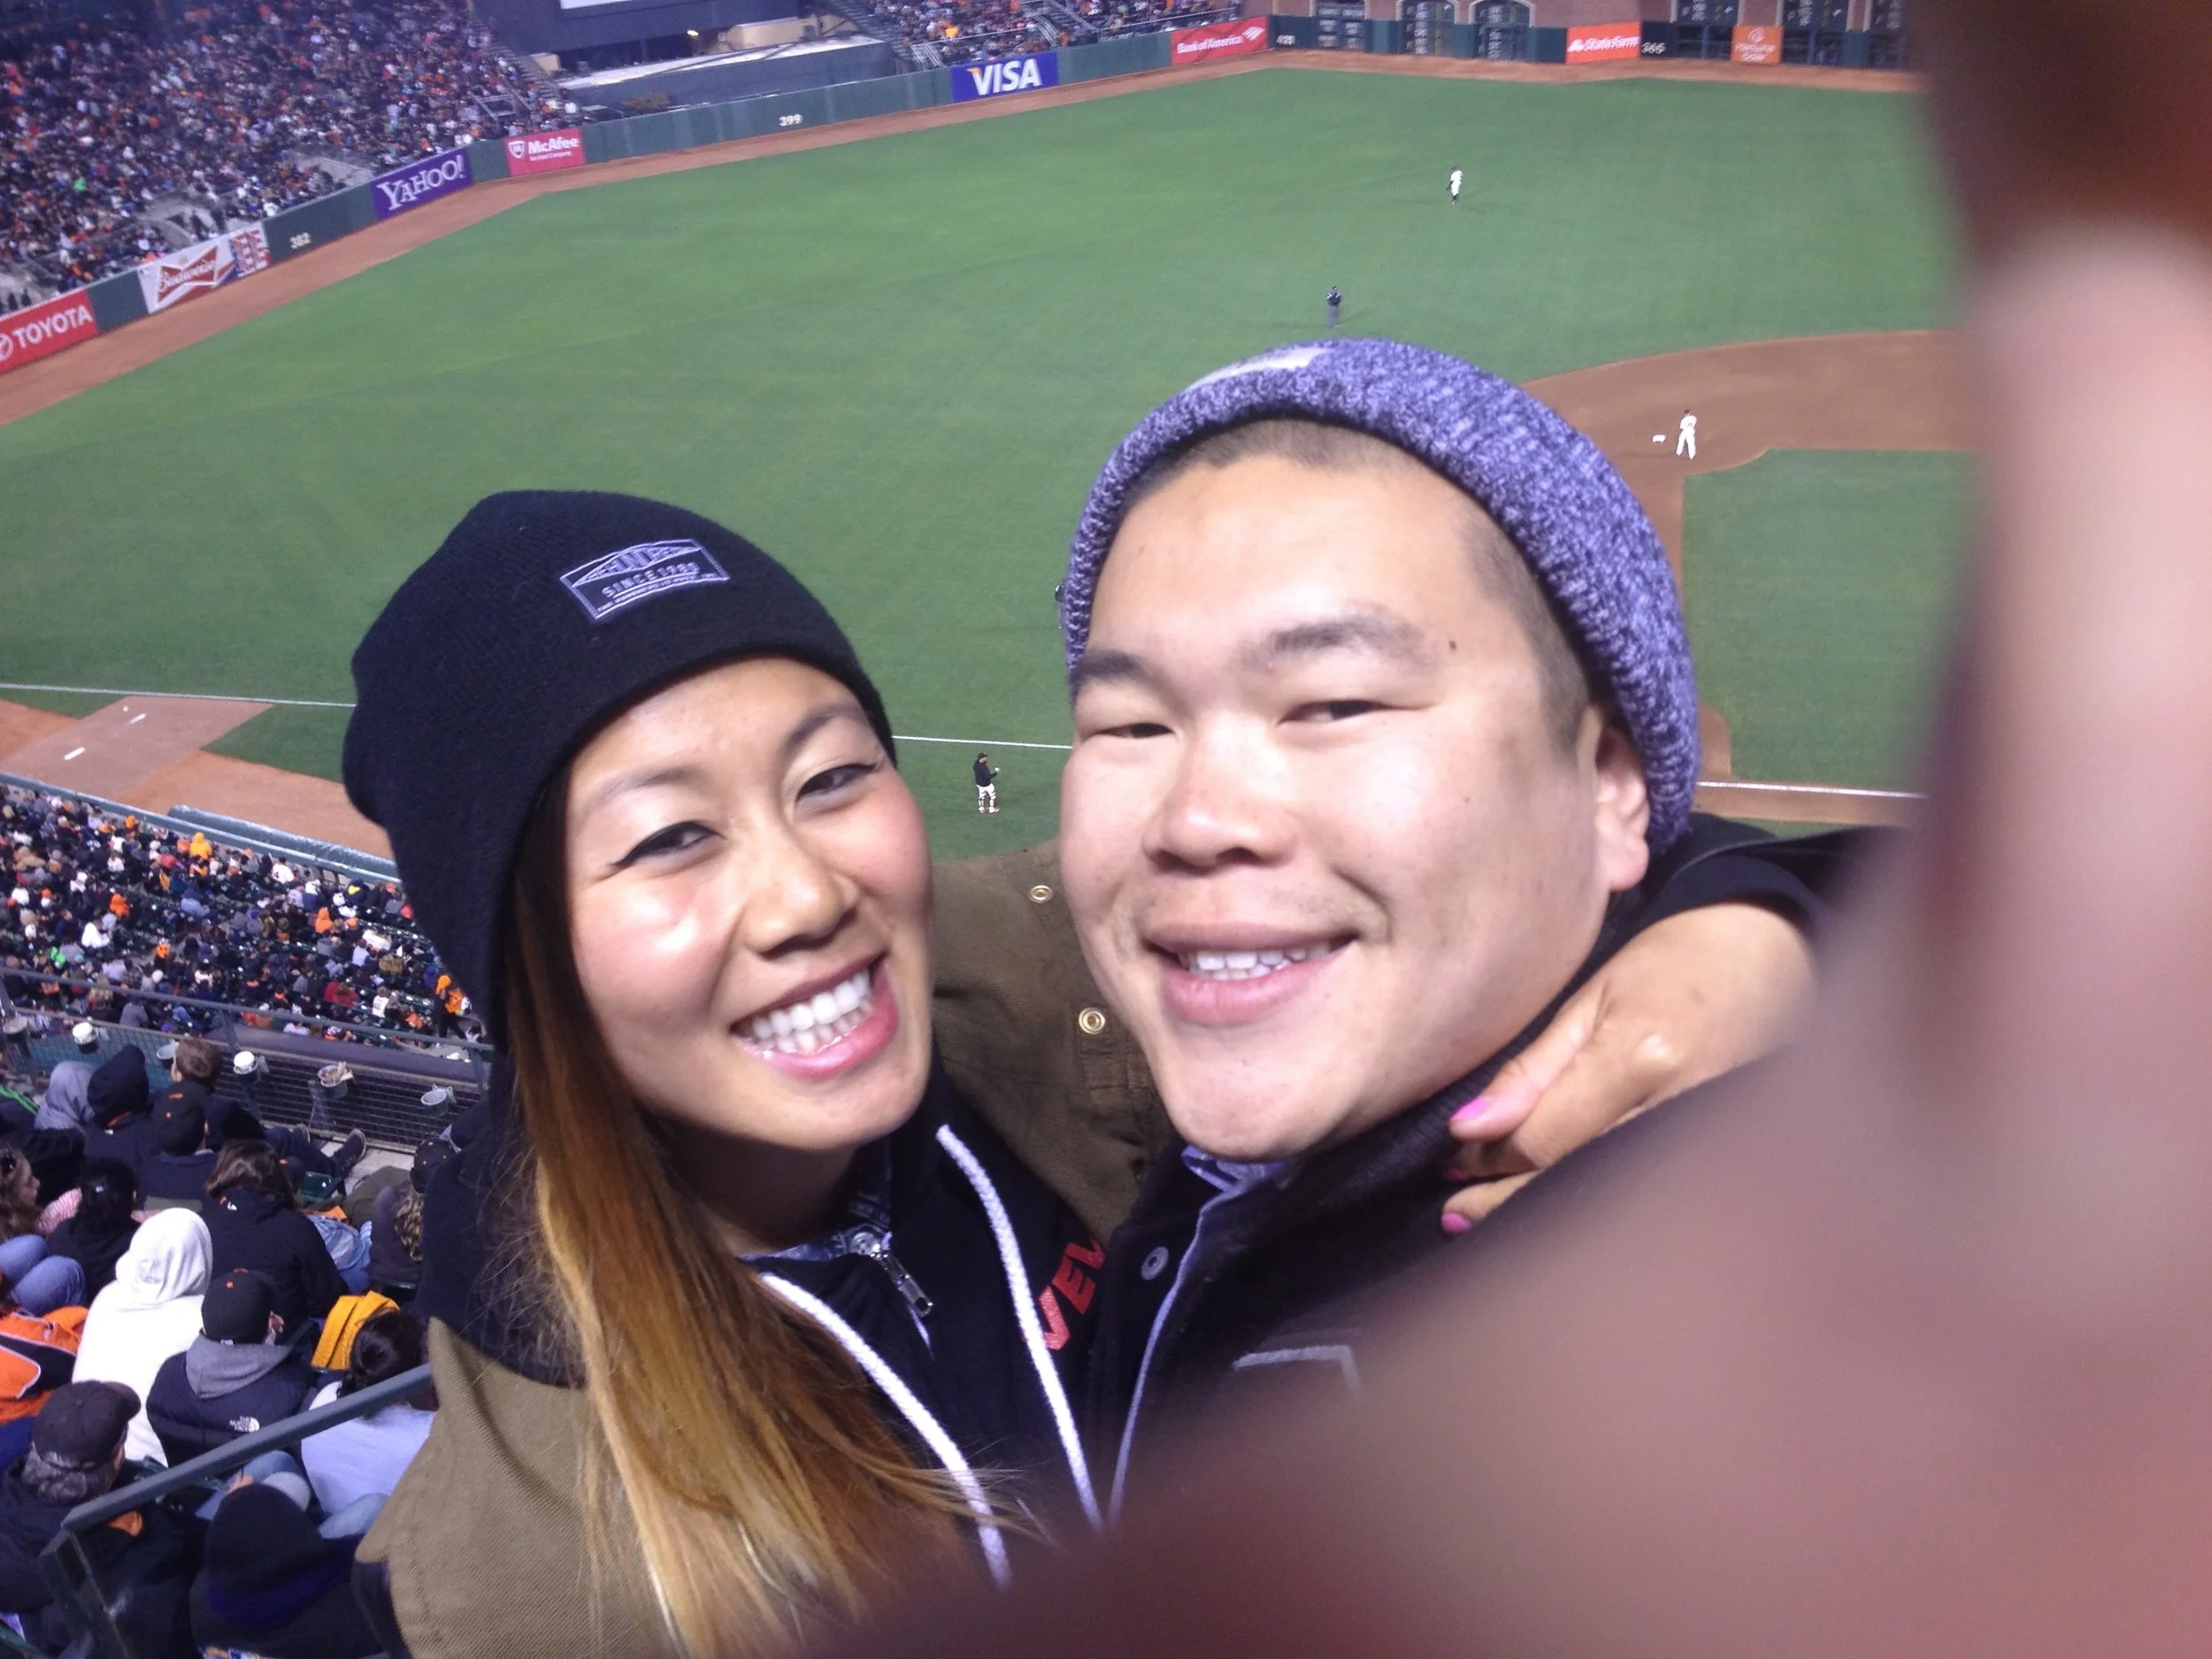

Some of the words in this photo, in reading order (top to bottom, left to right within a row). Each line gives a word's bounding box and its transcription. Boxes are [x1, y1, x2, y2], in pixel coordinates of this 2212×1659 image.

[1177, 40, 1198, 54] Bank
[1208, 34, 1243, 50] America
[1641, 42, 1666, 54] 365
[966, 58, 1042, 96] VISA
[779, 113, 803, 127] 399
[527, 136, 580, 154] McAfee
[376, 154, 465, 211] YAHOO!
[289, 233, 311, 249] 382
[159, 257, 216, 293] Budweiser
[12, 304, 93, 348] TOYOTA
[602, 570, 657, 597] SINCE
